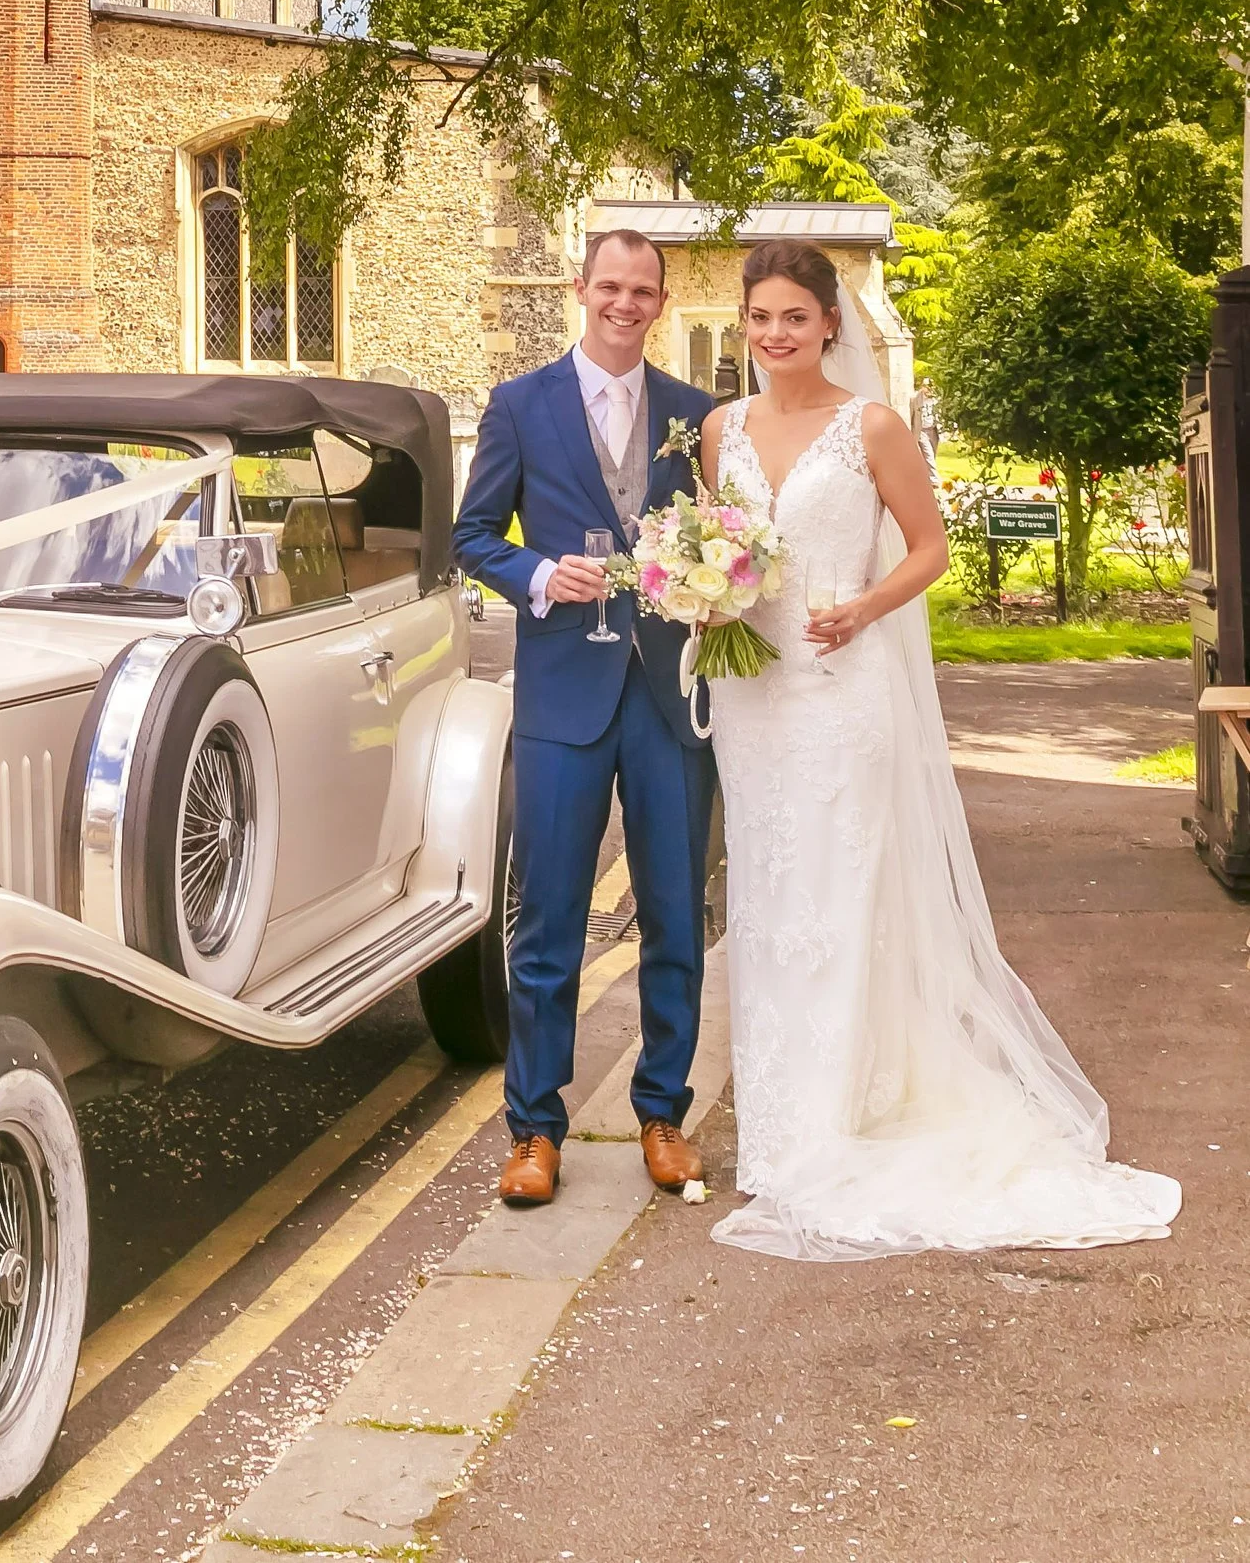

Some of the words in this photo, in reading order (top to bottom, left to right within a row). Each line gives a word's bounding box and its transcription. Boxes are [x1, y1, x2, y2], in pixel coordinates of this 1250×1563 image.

[990, 509, 1056, 520] Commonwealth
[999, 519, 1016, 528] War
[1017, 519, 1047, 529] Graves
